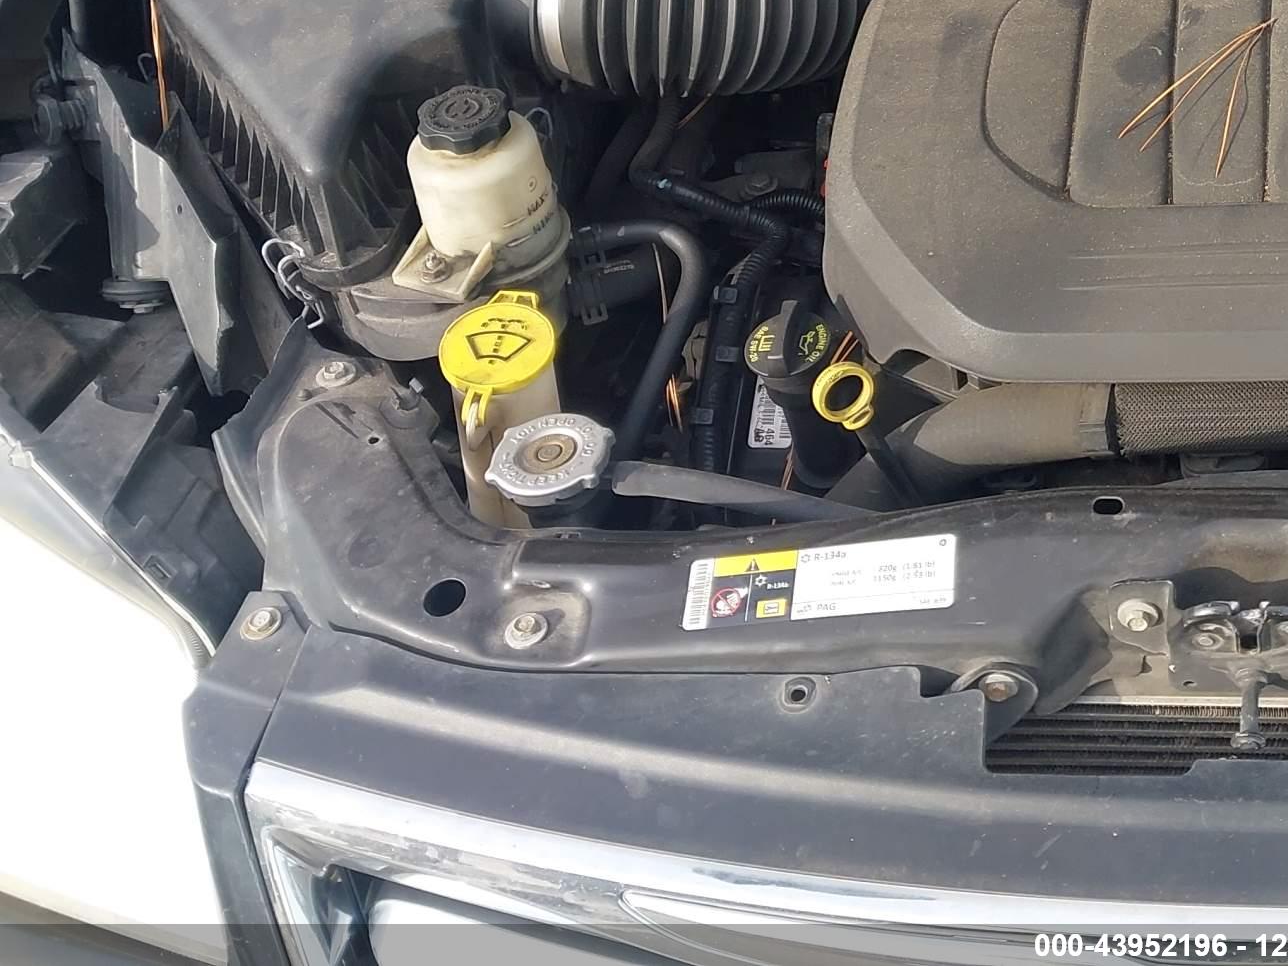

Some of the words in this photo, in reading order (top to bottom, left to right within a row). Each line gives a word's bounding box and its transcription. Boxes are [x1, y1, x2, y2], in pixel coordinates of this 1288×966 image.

[816, 324, 829, 351] ENGINE
[804, 350, 821, 363] OIL
[817, 603, 836, 611] PAG
